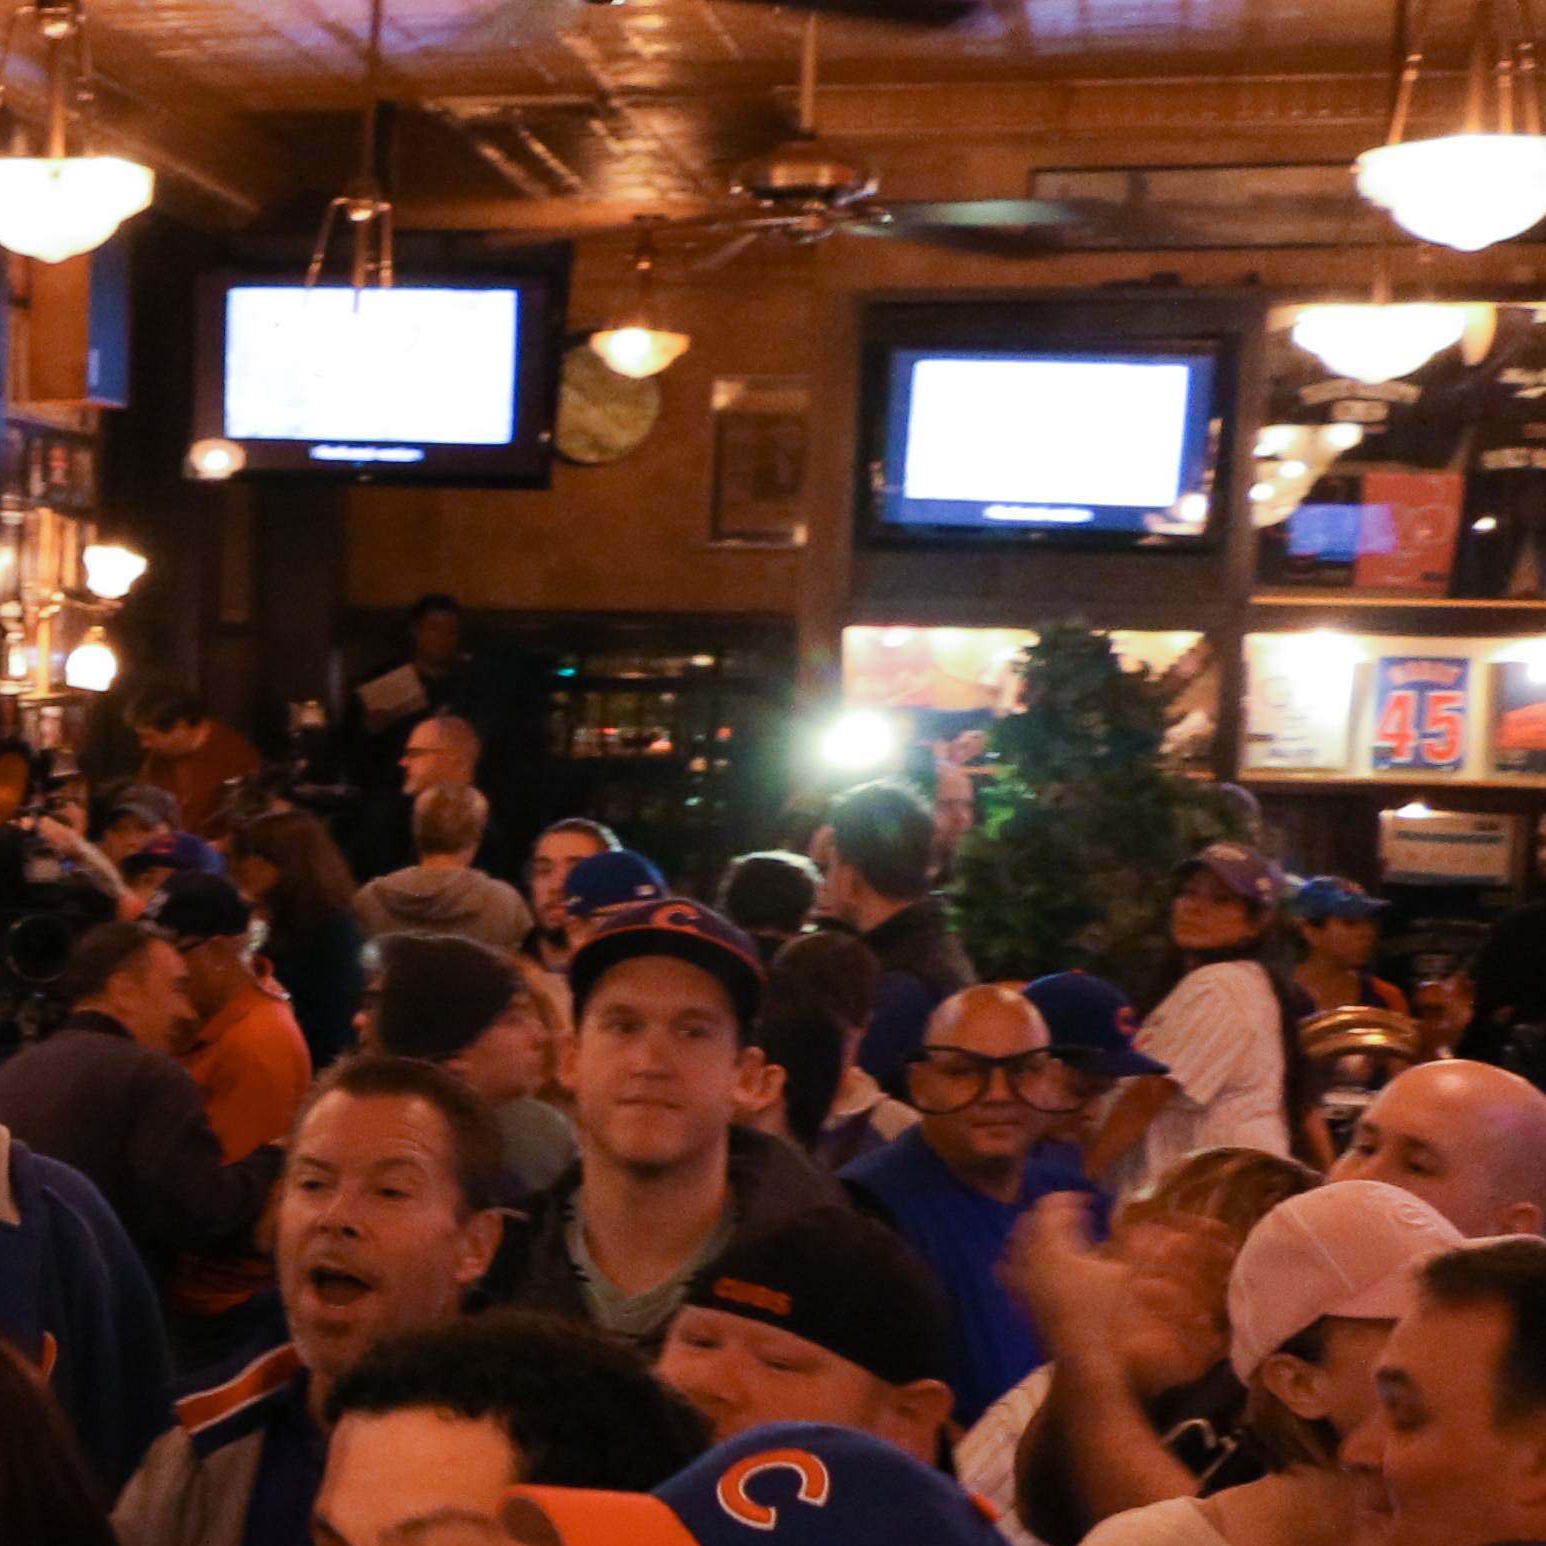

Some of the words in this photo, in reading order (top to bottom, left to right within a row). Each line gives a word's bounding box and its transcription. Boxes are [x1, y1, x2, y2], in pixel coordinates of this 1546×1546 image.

[1374, 689, 1466, 764] 45
[651, 903, 701, 933] C
[715, 1447, 830, 1531] C
